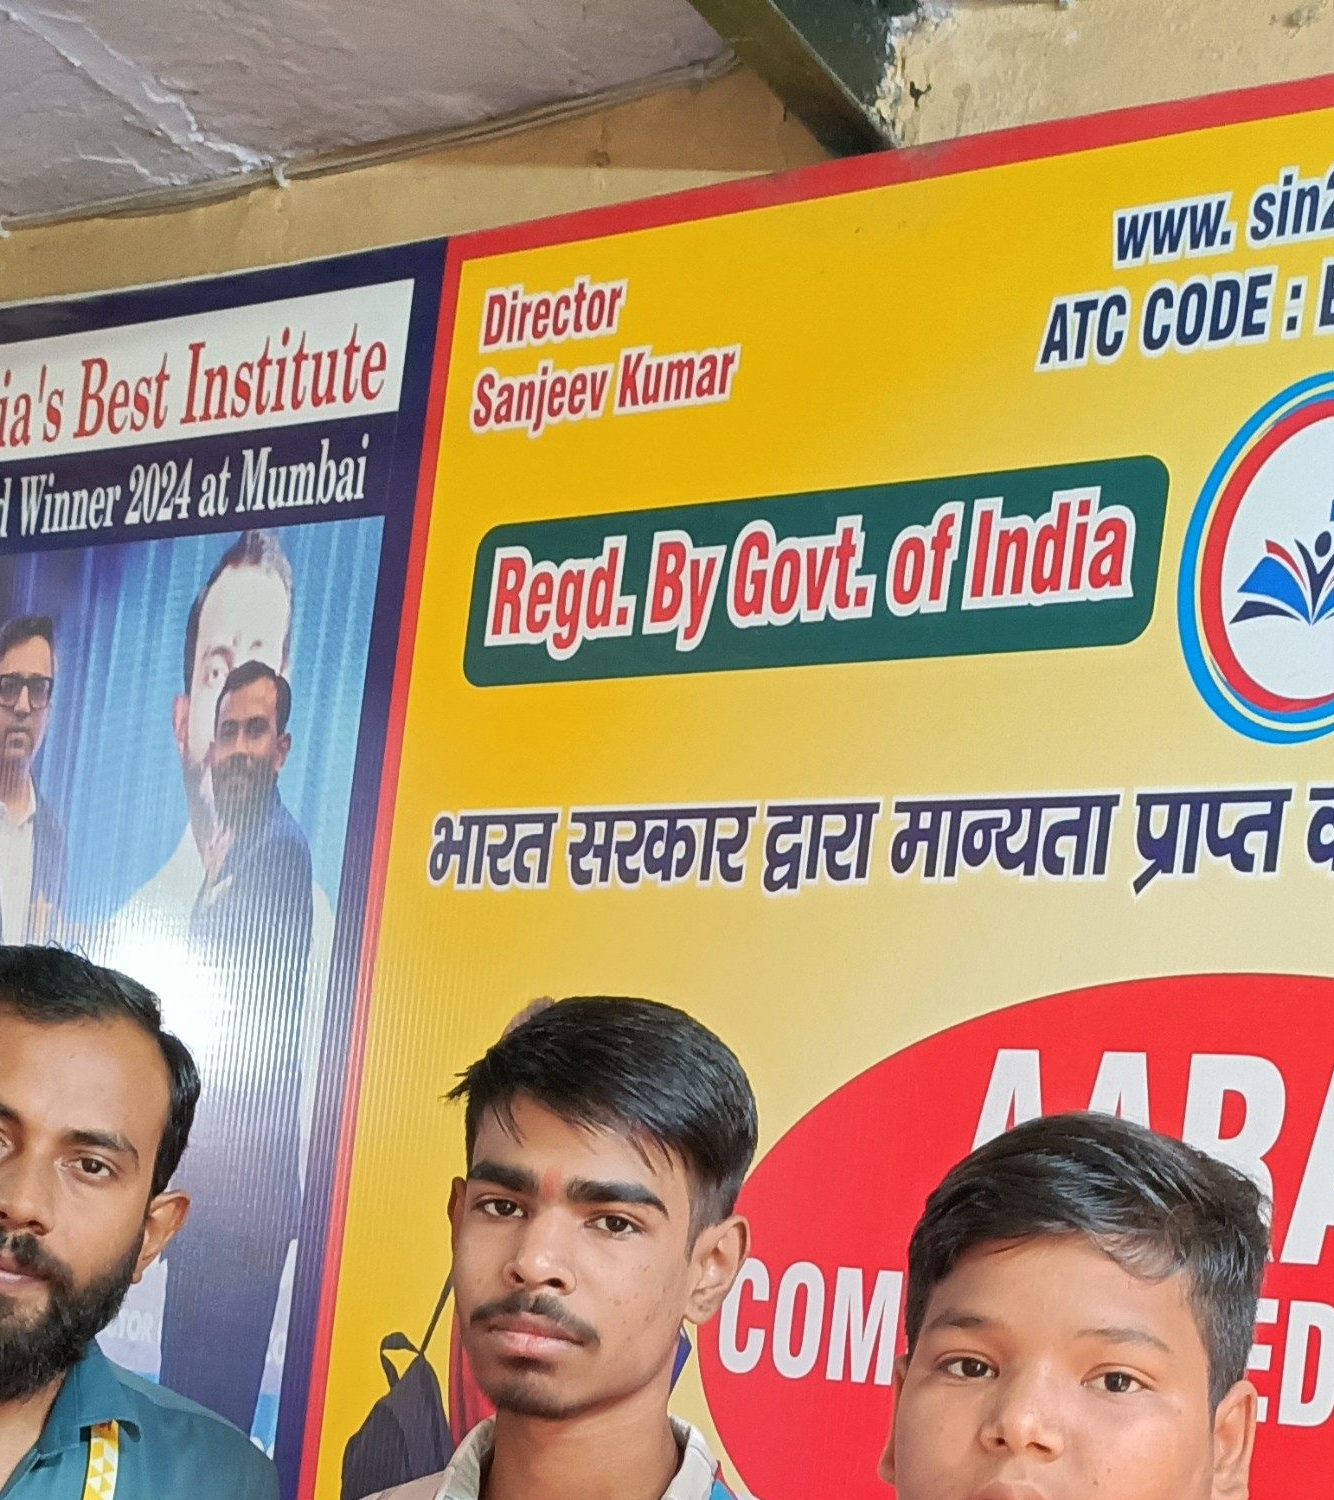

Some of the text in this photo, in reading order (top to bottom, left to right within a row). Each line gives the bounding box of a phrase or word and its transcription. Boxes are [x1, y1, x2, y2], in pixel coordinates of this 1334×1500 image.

[1116, 202, 1231, 260] www.
[483, 283, 624, 347] Director
[1041, 295, 1125, 365] ATC
[1142, 275, 1269, 351] CODE
[74, 352, 170, 438] Best
[180, 324, 387, 426] Institute
[473, 349, 736, 434] Sanjeev Kumar
[19, 472, 121, 530] Winner
[124, 462, 192, 525] 2024
[198, 473, 230, 518] at
[235, 433, 369, 513] Mumbai
[492, 498, 1130, 650] Regd. By Govt. of India
[430, 813, 558, 888] भारत
[569, 806, 757, 886] सरकार
[764, 803, 879, 893] द्वारा
[891, 796, 1121, 879] मान्यता
[1131, 790, 1293, 893] प्राप्त
